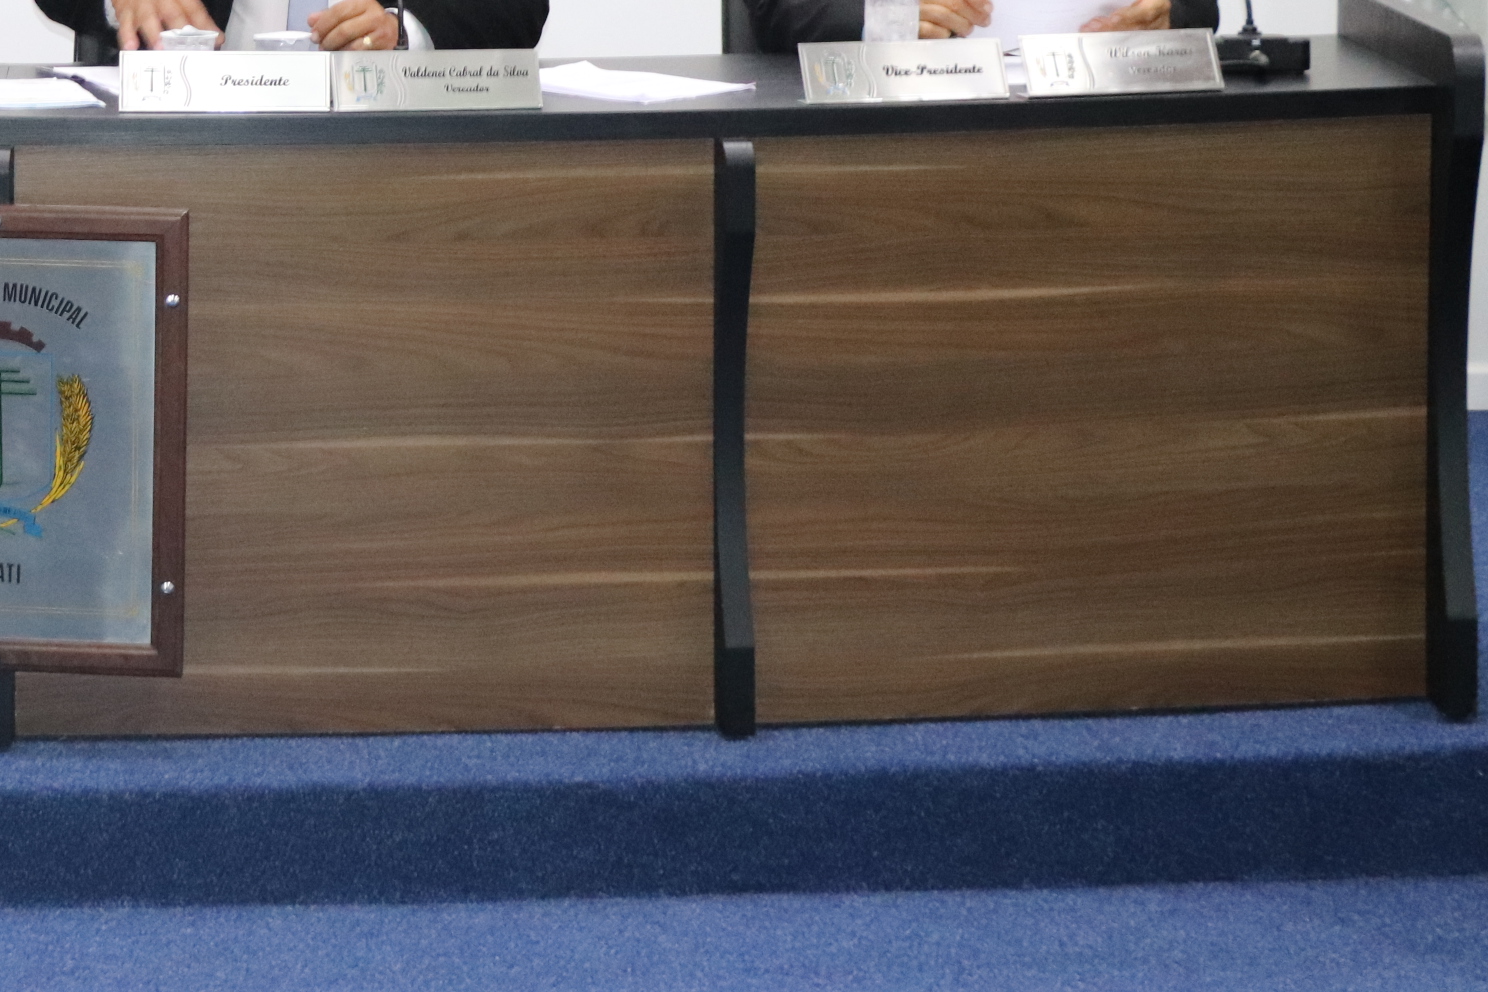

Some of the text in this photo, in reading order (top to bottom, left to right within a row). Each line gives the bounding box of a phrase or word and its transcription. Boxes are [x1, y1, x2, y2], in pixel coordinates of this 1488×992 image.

[401, 65, 529, 78] Valdenei Cabral da Silva
[882, 62, 984, 76] Vice-Presidente
[219, 74, 291, 86] Presidente
[443, 82, 490, 92] Vereador
[2, 282, 89, 330] MUNICIPAL
